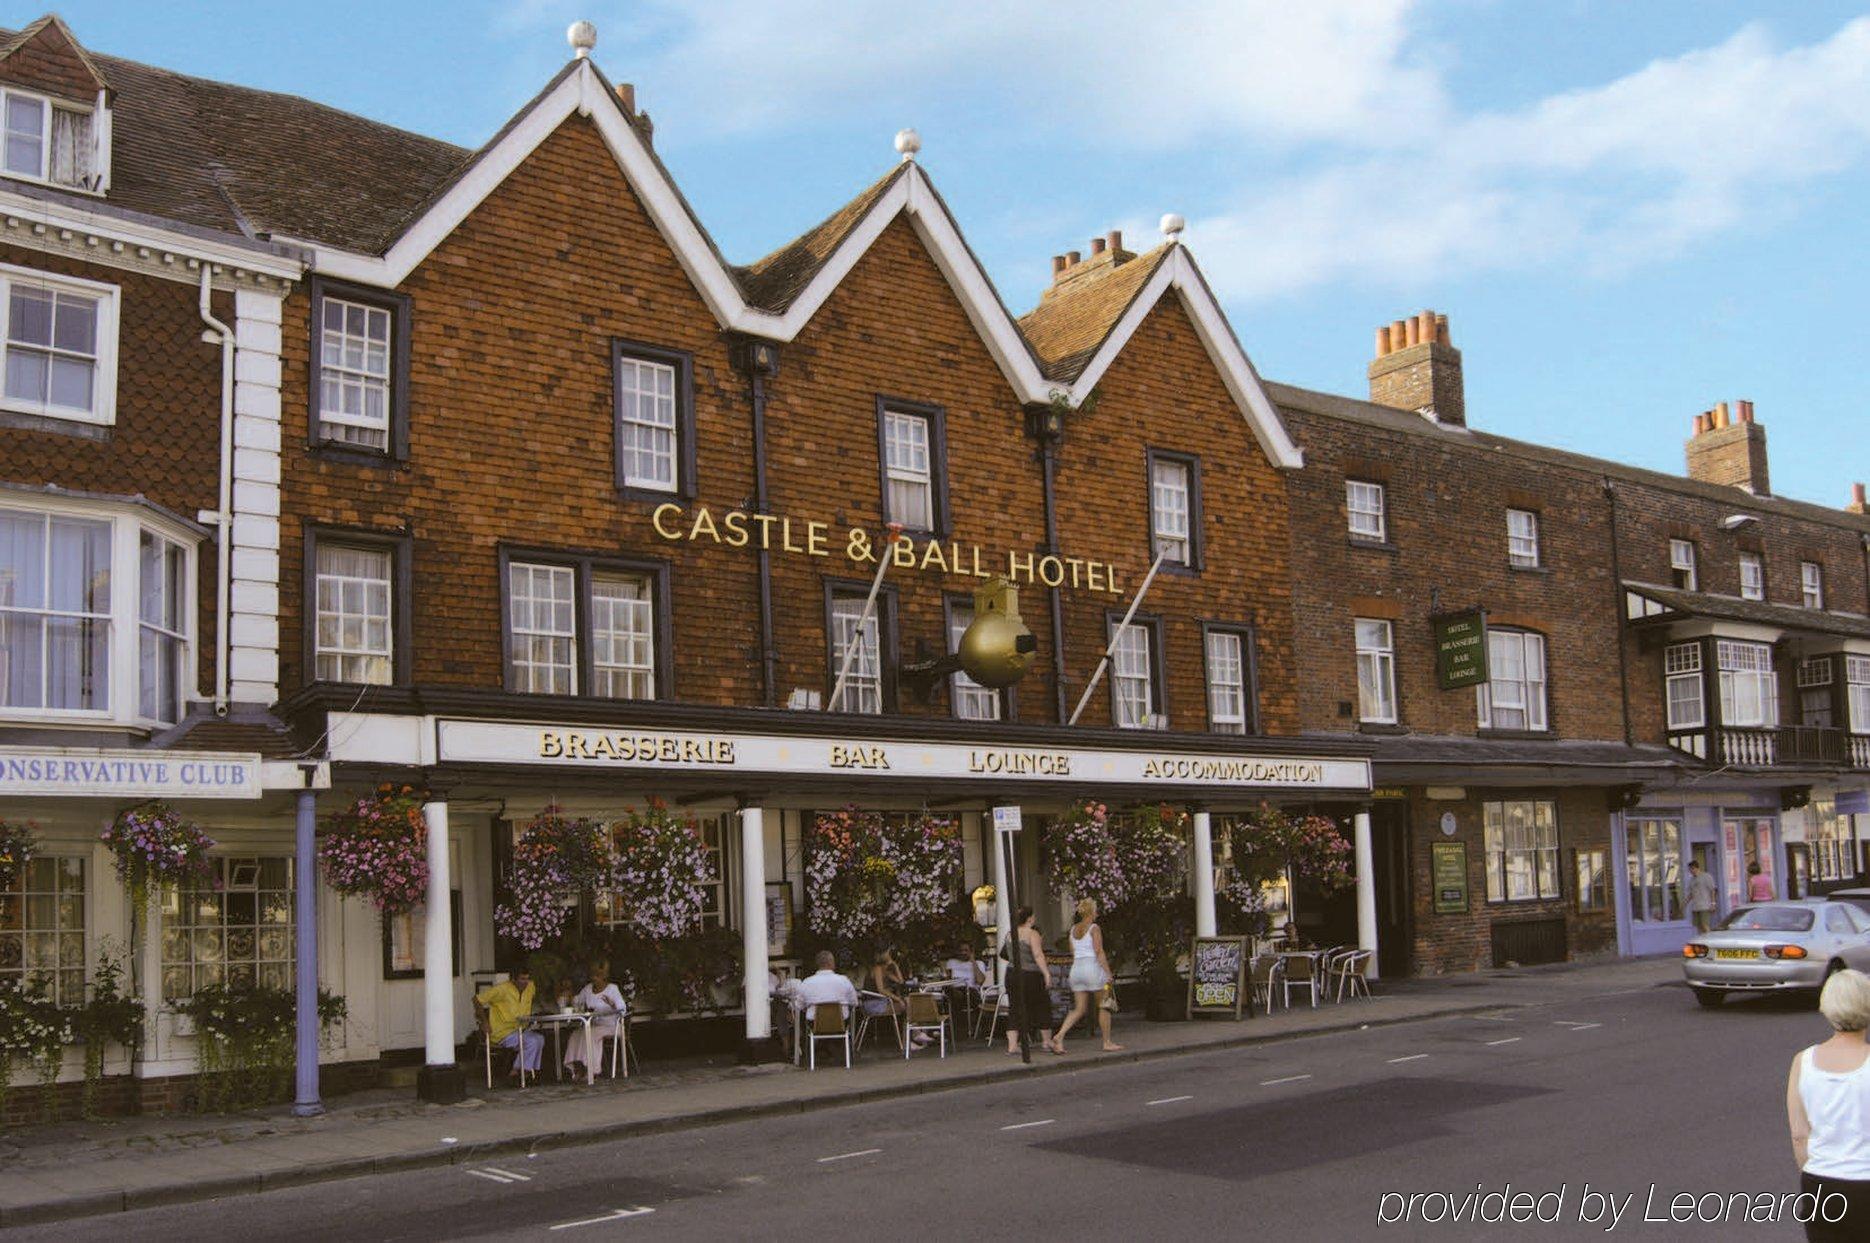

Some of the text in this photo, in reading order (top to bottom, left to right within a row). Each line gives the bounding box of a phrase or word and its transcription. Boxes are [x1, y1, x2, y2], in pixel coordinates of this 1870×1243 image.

[652, 502, 1125, 595] CASTLE & BALL HOTEL
[1447, 623, 1471, 634] HOTEL
[1441, 635, 1480, 651] BRASSERIE
[1454, 653, 1469, 664] BAR
[1449, 667, 1476, 680] LOUNGE
[539, 732, 1323, 783] BRASSERIE BAR LOUNGE ACCOMMODATION
[180, 763, 246, 785] CLUB
